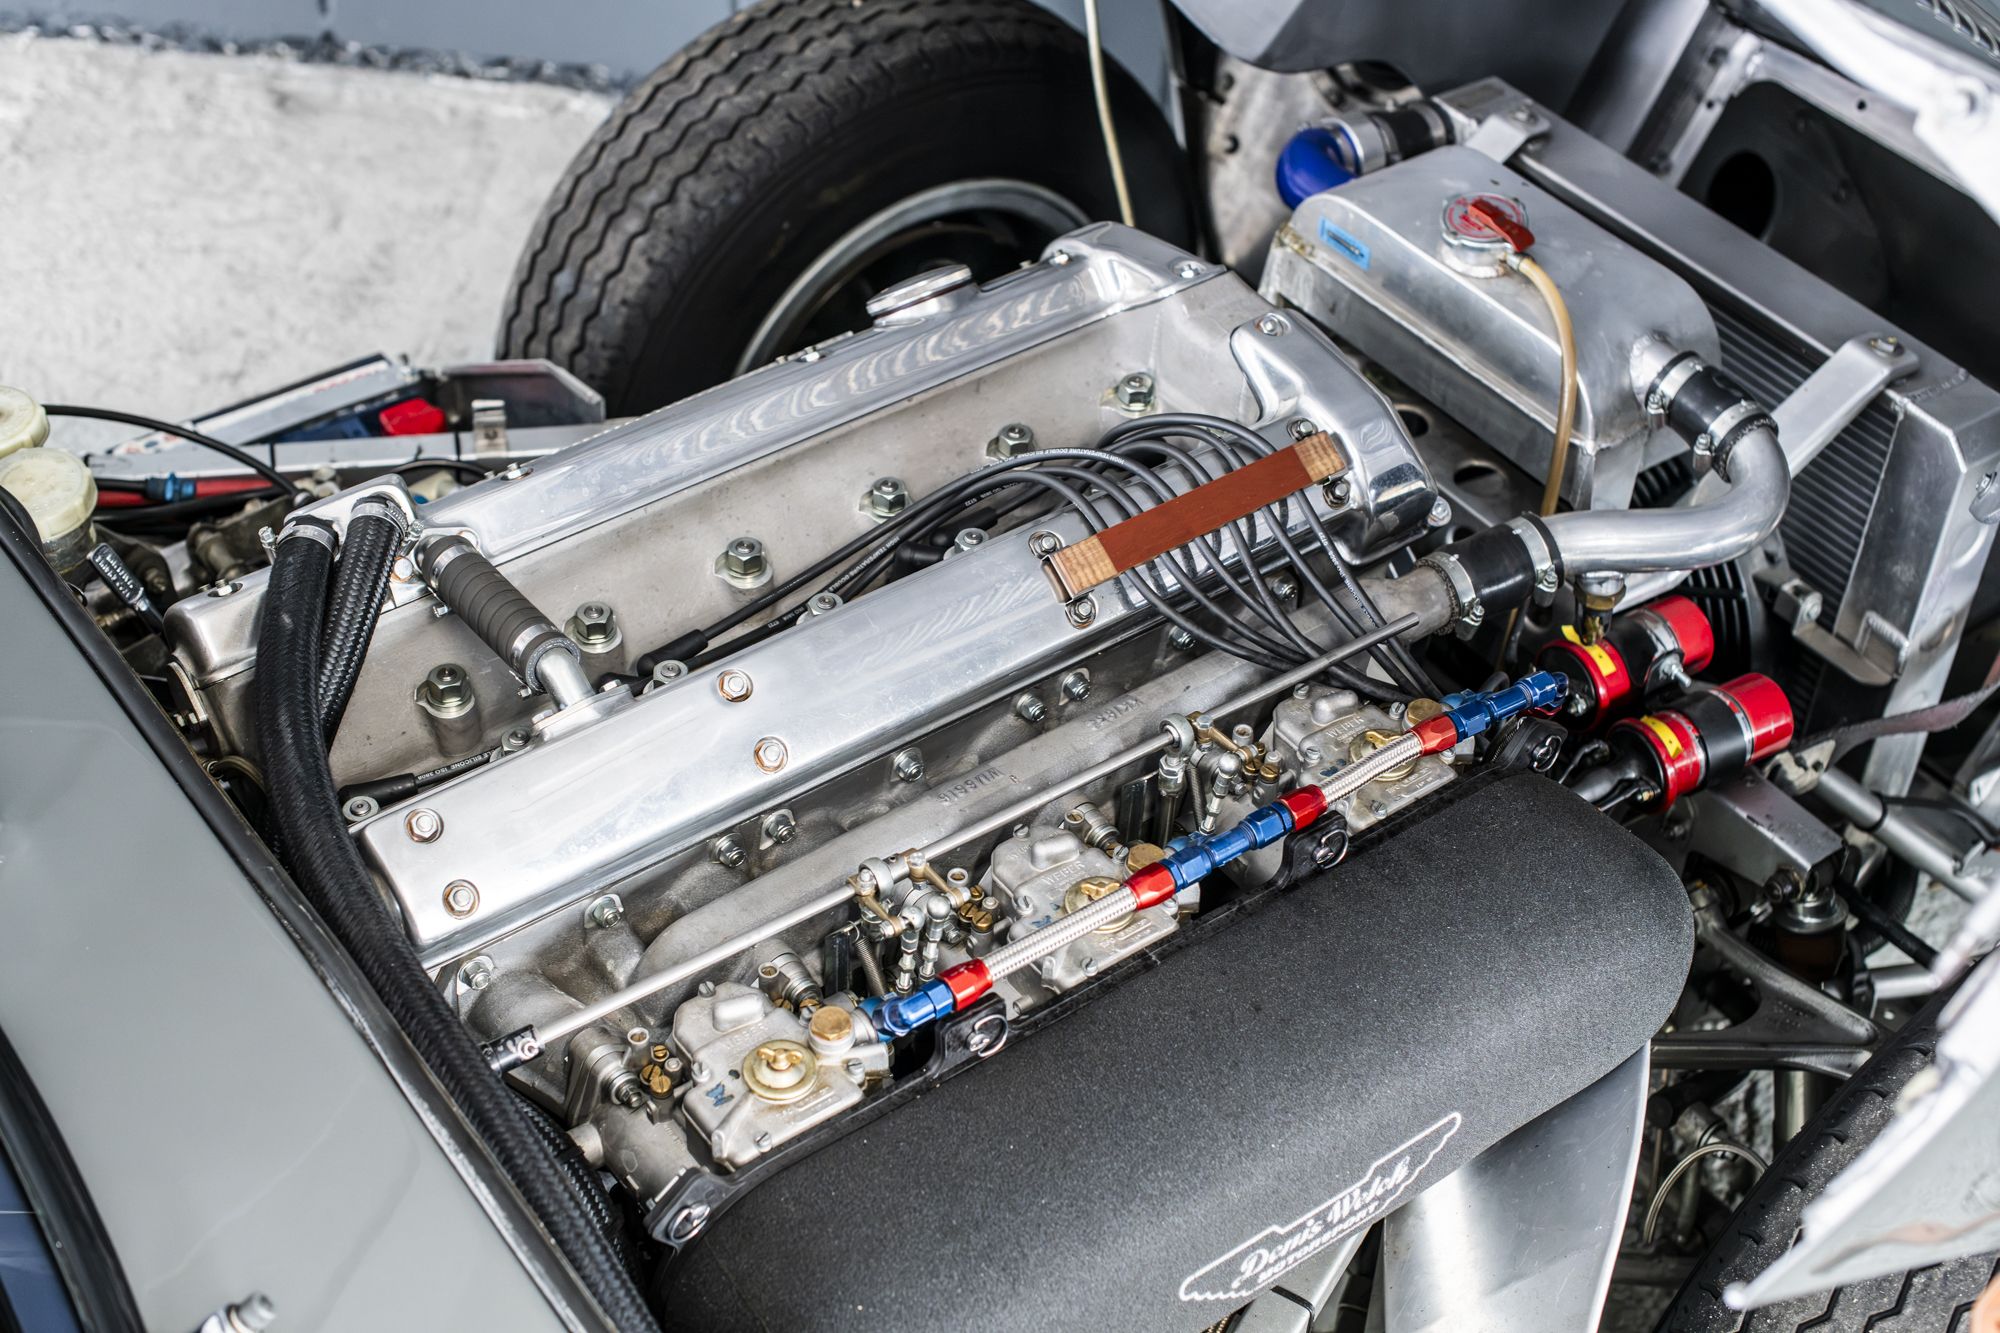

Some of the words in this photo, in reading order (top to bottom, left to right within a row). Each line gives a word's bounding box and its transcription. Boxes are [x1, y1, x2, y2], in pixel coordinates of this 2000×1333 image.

[1044, 447, 1068, 455] DOUBLE
[1068, 447, 1110, 460] TEMPERATURE
[1110, 454, 1125, 466] HIGH
[885, 535, 900, 550] HIGH
[850, 545, 887, 578] TEMPERATURE
[1326, 713, 1366, 739] WEBER
[450, 755, 483, 769] SILICONE
[435, 767, 448, 775] ISO
[1041, 860, 1086, 885] WEBER
[1231, 1219, 1324, 1289] Denis
[1327, 1155, 1410, 1224] Welch
[1257, 1200, 1380, 1284] MOTORSPORT
